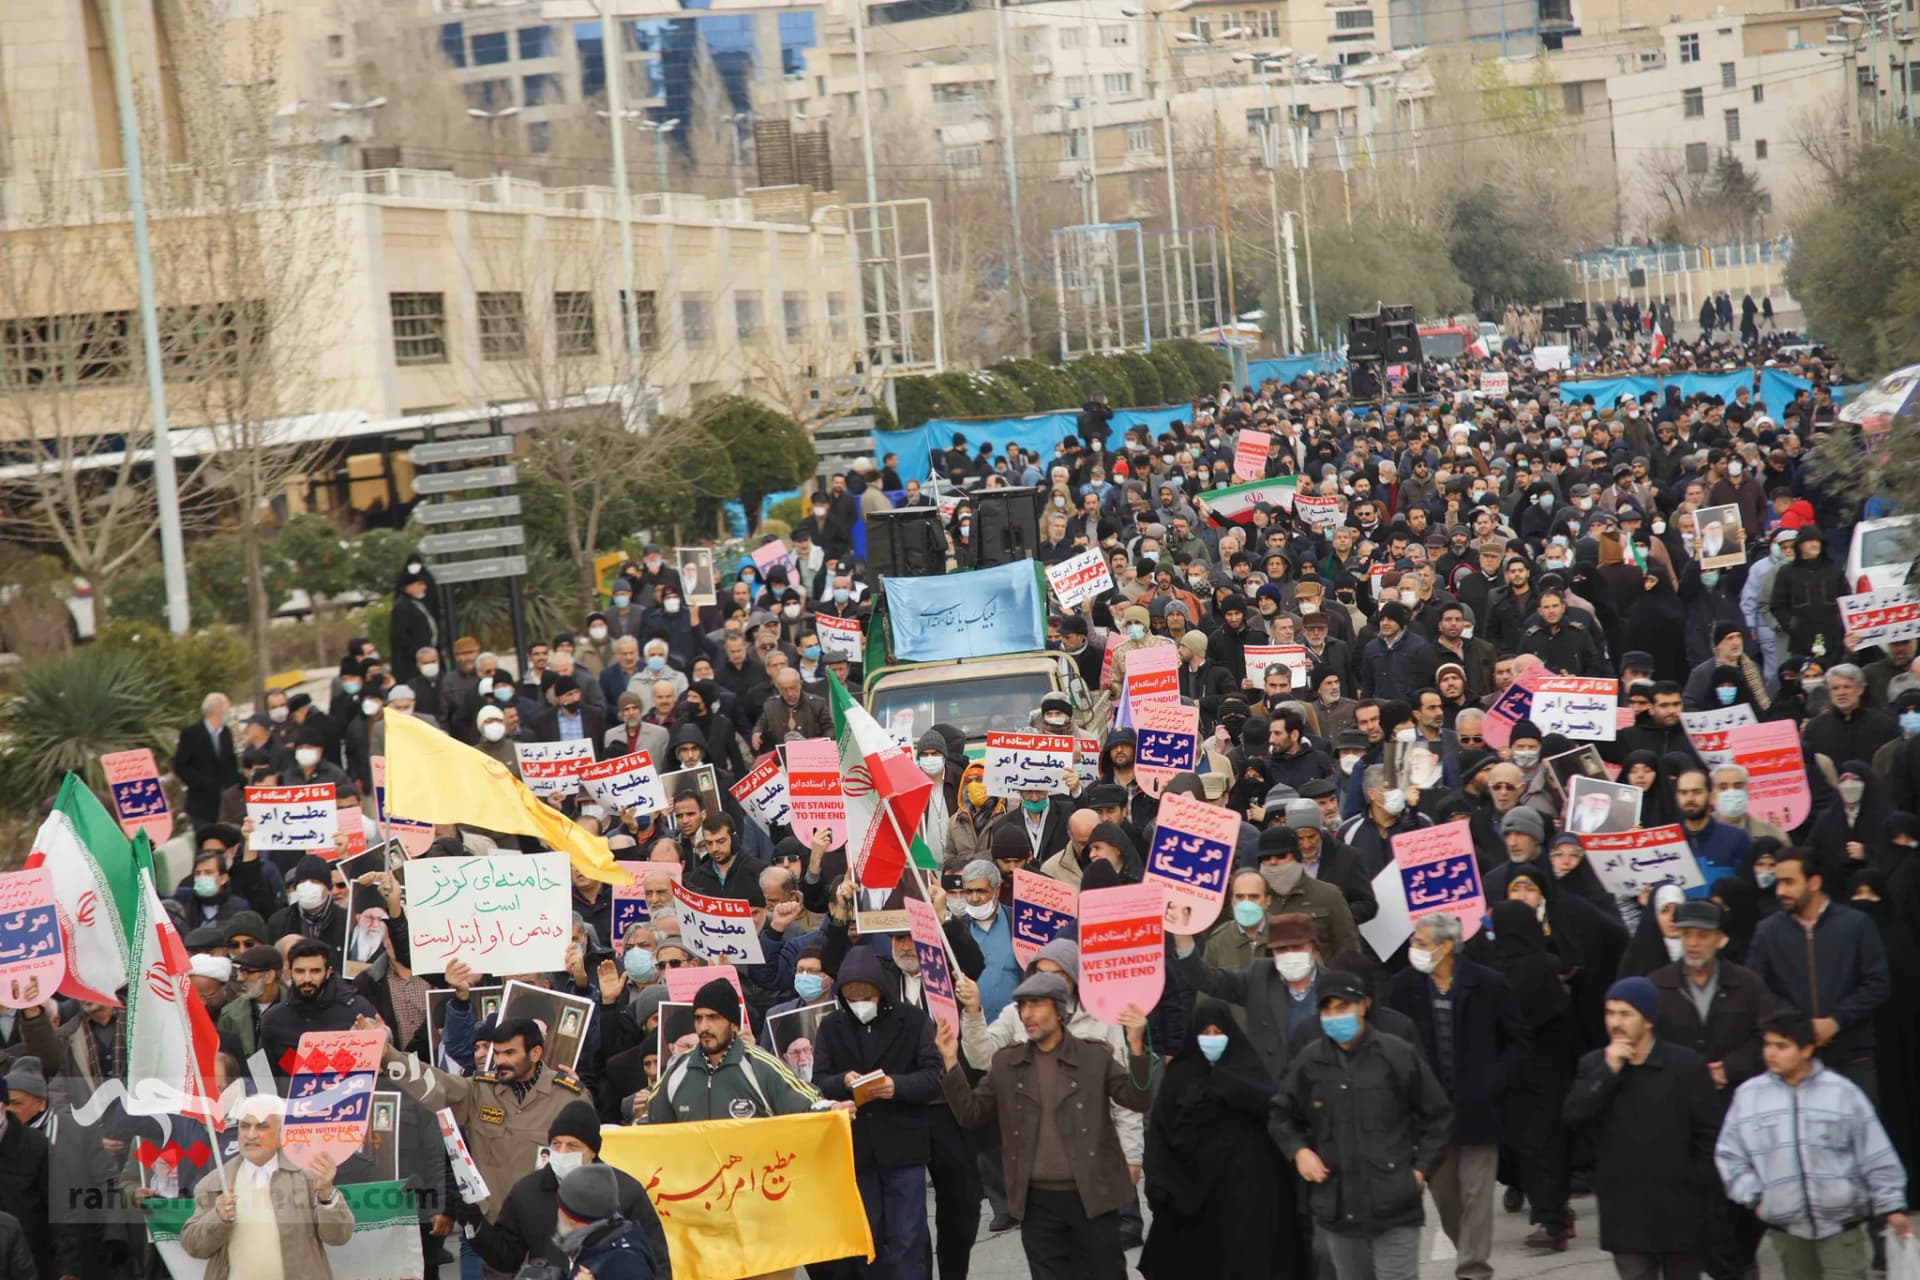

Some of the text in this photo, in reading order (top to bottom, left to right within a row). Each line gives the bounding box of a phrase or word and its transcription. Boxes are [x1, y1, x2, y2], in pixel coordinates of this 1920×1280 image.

[1084, 554, 1098, 564] مرگ
[964, 592, 1000, 629] لبیک
[956, 610, 964, 632] یا
[1158, 677, 1172, 688] آخر
[1540, 696, 1562, 712] امر
[1564, 698, 1608, 714] مطیع
[1551, 720, 1604, 735] رهبریم
[992, 736, 1069, 749] ما تا آخر ایستاده ایم
[1142, 733, 1188, 750] مرگ بر
[520, 744, 588, 760] مرگ بر آمریکا
[637, 756, 646, 764] ما
[1140, 748, 1189, 768] امریکا
[614, 760, 629, 772] آخر
[765, 765, 774, 774] ما
[994, 752, 1065, 770] مطیع امر
[523, 763, 556, 778] اسرائیل
[592, 764, 614, 777] ایستاده
[594, 773, 650, 798] مطیع امر
[750, 772, 761, 788] آخر
[790, 778, 841, 790] آخر ایستاده ایم
[1004, 774, 1059, 788] رهبریم
[119, 780, 157, 800] مرگ بر
[249, 787, 330, 802] ما تا آخر ایستاده ایم
[756, 783, 784, 811] مطیع
[120, 796, 164, 814] امریکا
[792, 801, 844, 810] WE STANDU
[257, 806, 328, 825] مطیع امر
[796, 812, 846, 820] TO THE END
[271, 829, 326, 845] رهبریم
[1636, 830, 1655, 847] آخر
[1159, 836, 1223, 862] مرگ بر
[1154, 852, 1220, 886] امریکا
[1605, 850, 1680, 872] مطیع امر
[414, 858, 482, 908] کوثر
[1410, 861, 1468, 888] مرگ بر
[1410, 878, 1474, 905] امریکا
[474, 893, 520, 913] است
[682, 892, 704, 910] ایستاده
[706, 900, 723, 913] آخر
[725, 903, 733, 913] تا
[734, 906, 745, 914] ما
[1020, 908, 1034, 921] بر
[4, 911, 50, 932] مرگ
[510, 913, 564, 946] دشمن
[682, 911, 746, 939] مطیع امر
[480, 920, 504, 956] او
[1082, 923, 1162, 948] تا آخر ایستاده ایم
[693, 938, 748, 960] رهبریم
[920, 946, 944, 970] مرگ بر
[1082, 960, 1105, 971] WE
[922, 968, 950, 996] امریکا
[1088, 966, 1156, 983] TO THE END
[296, 1074, 365, 1097] مرگ بر
[292, 1097, 363, 1122] امریکا
[286, 1127, 312, 1136] DOWN
[315, 1126, 337, 1134] WITH
[645, 1150, 796, 1217] مطیع امر رهبریم
